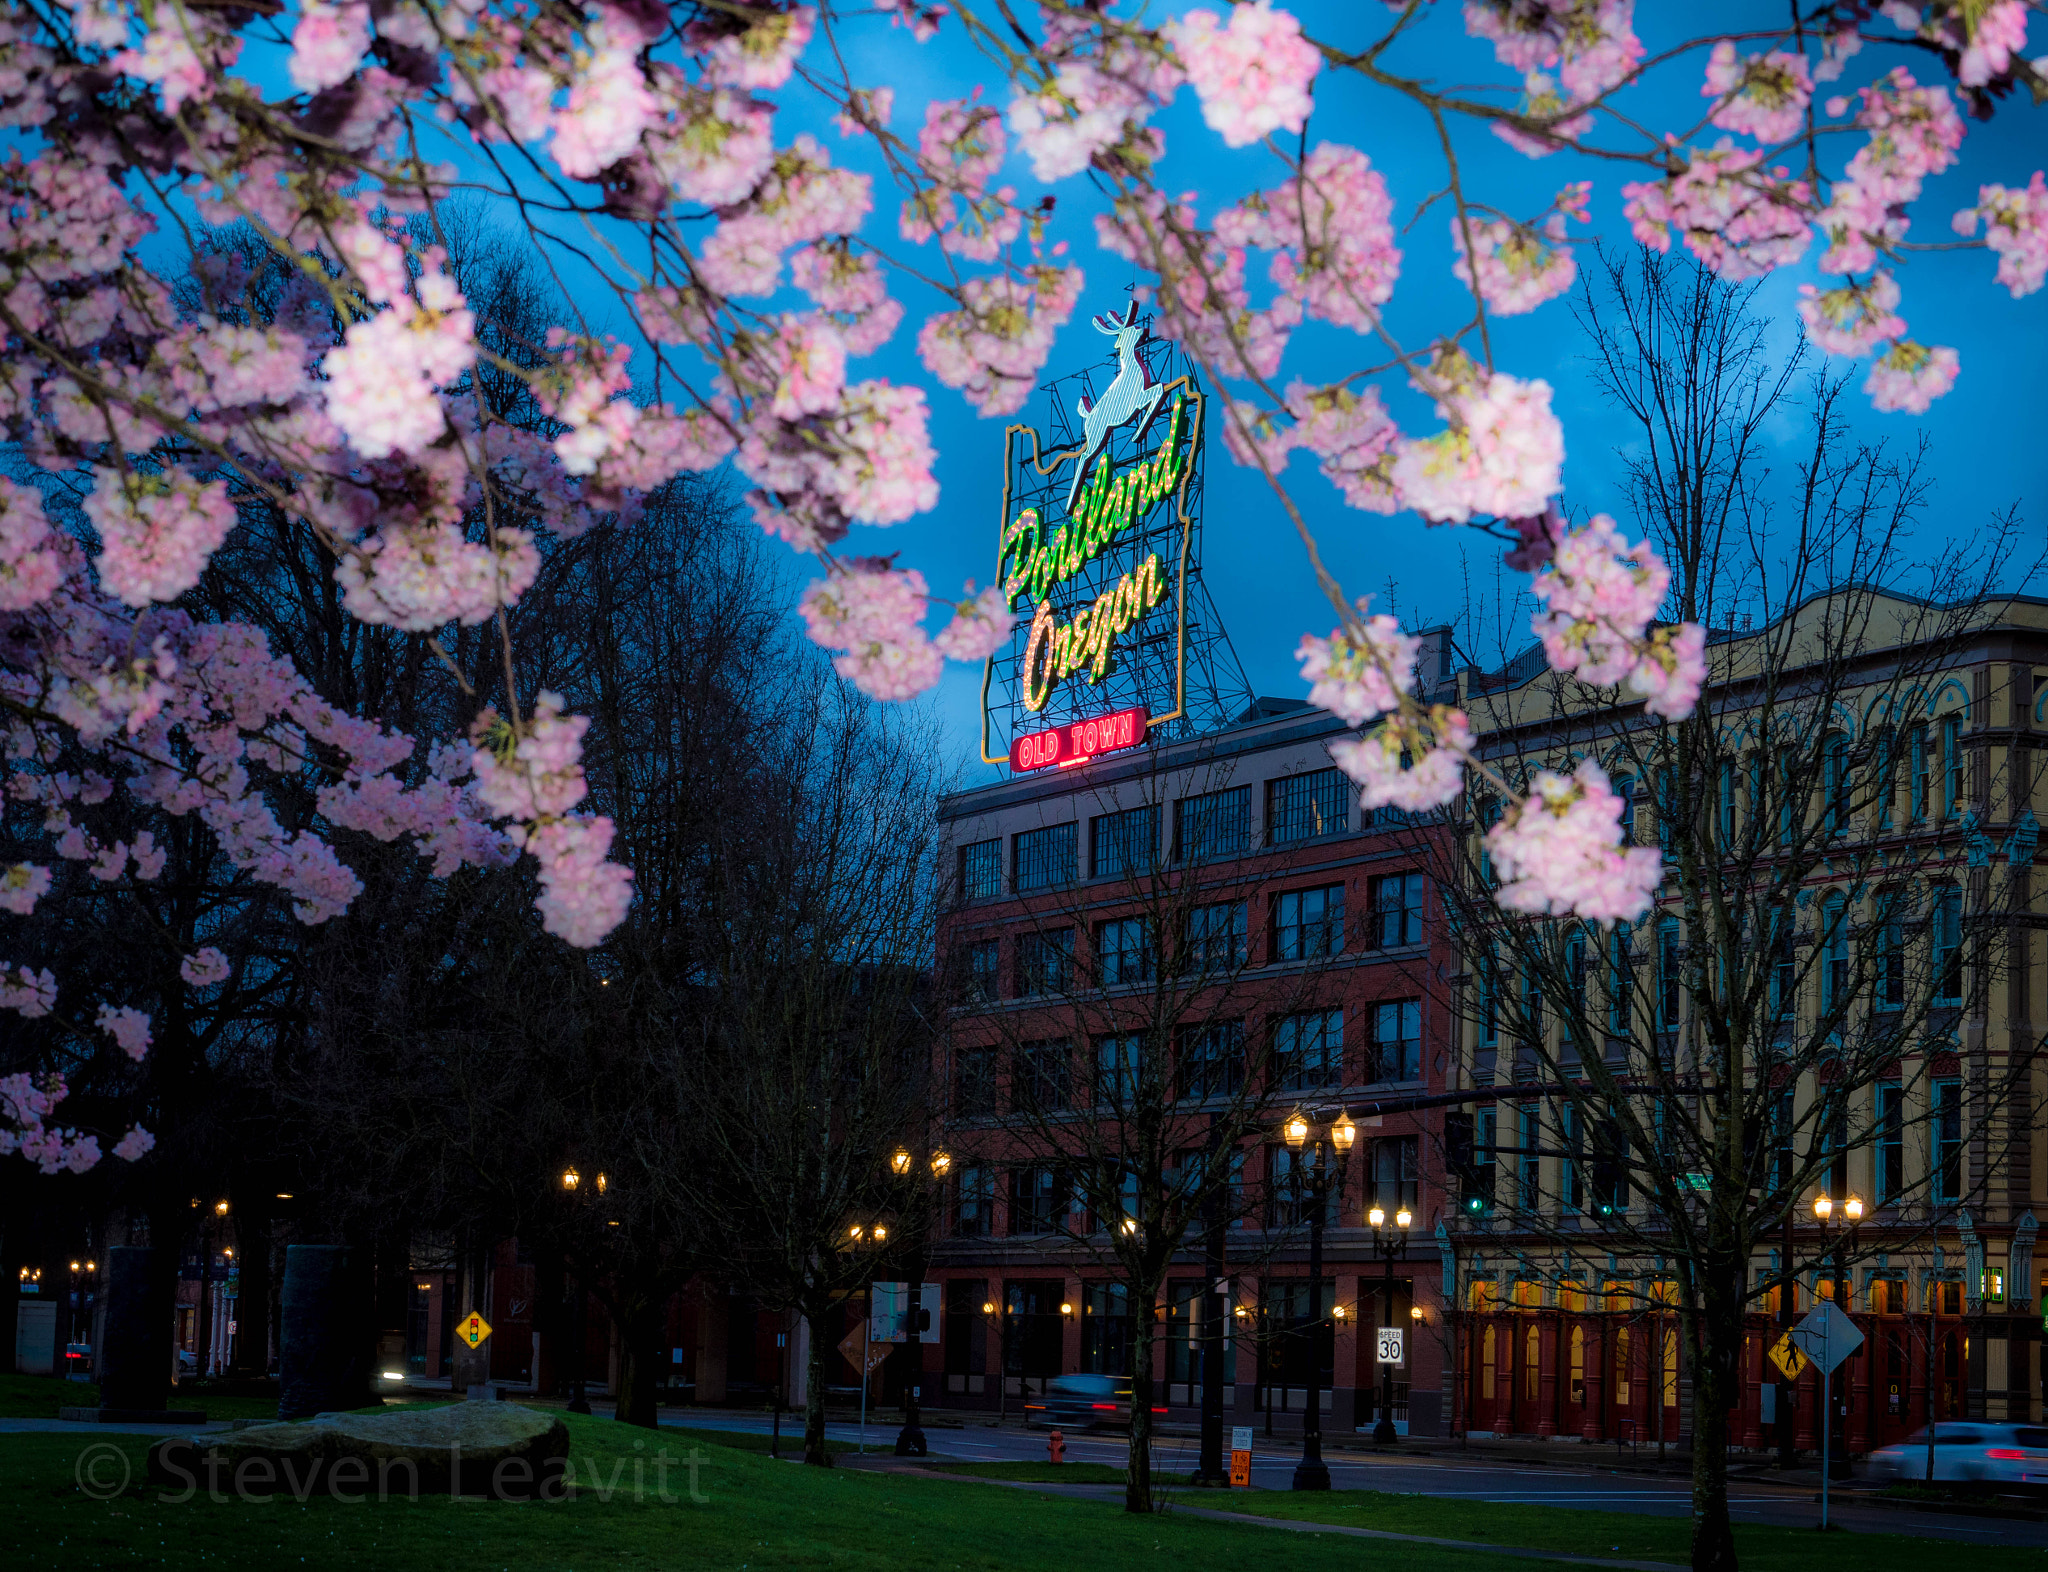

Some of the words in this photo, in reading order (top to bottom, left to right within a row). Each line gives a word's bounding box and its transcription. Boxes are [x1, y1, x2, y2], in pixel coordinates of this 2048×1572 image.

[1001, 393, 1182, 614] Portland
[1023, 553, 1165, 712] Oregon
[1019, 732, 1059, 768] OLD
[1071, 713, 1133, 756] TOWN
[1379, 1331, 1401, 1339] SPEED
[1379, 1340, 1401, 1359] 30
[1232, 1465, 1249, 1474] DETOUR
